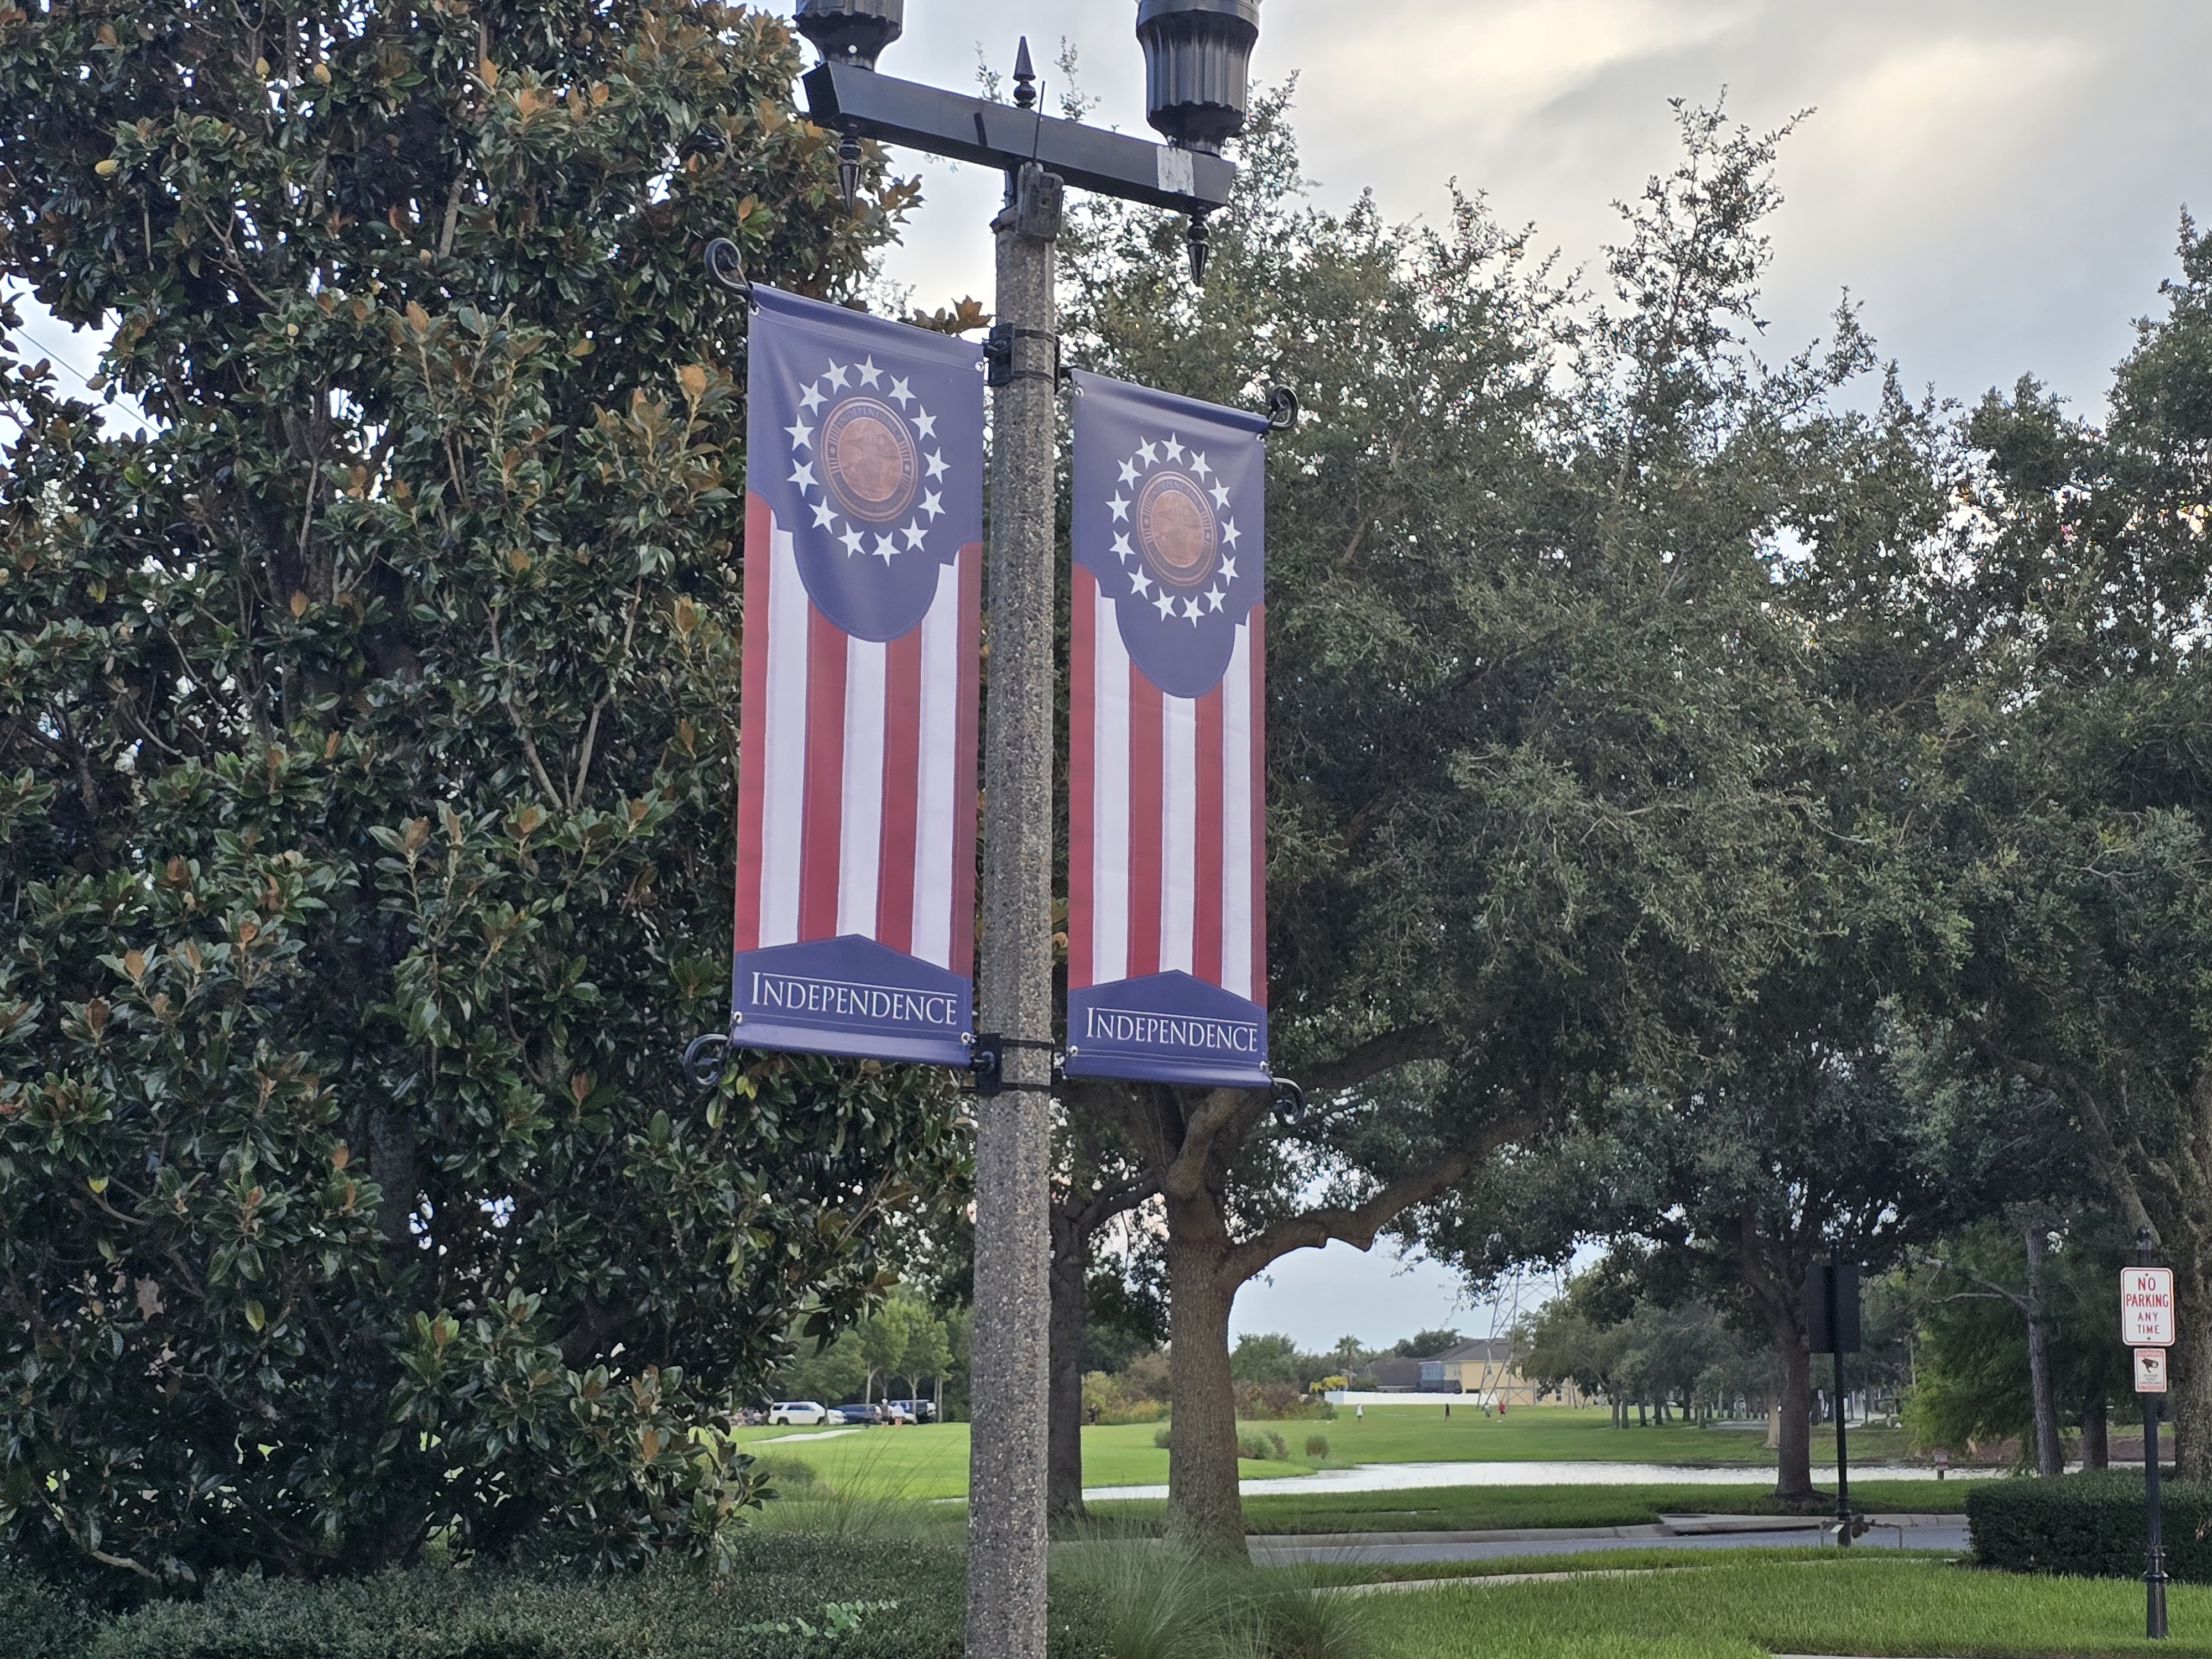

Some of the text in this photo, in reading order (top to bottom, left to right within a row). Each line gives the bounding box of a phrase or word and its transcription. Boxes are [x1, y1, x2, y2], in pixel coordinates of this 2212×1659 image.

[752, 972, 957, 1025] INDEPENDENCE
[1087, 1008, 1258, 1052] INDEPENDENCE
[2138, 1277, 2156, 1291] NO
[2126, 1293, 2168, 1307] PARKING
[2138, 1312, 2158, 1322] ANY
[2137, 1324, 2159, 1334] TIME
